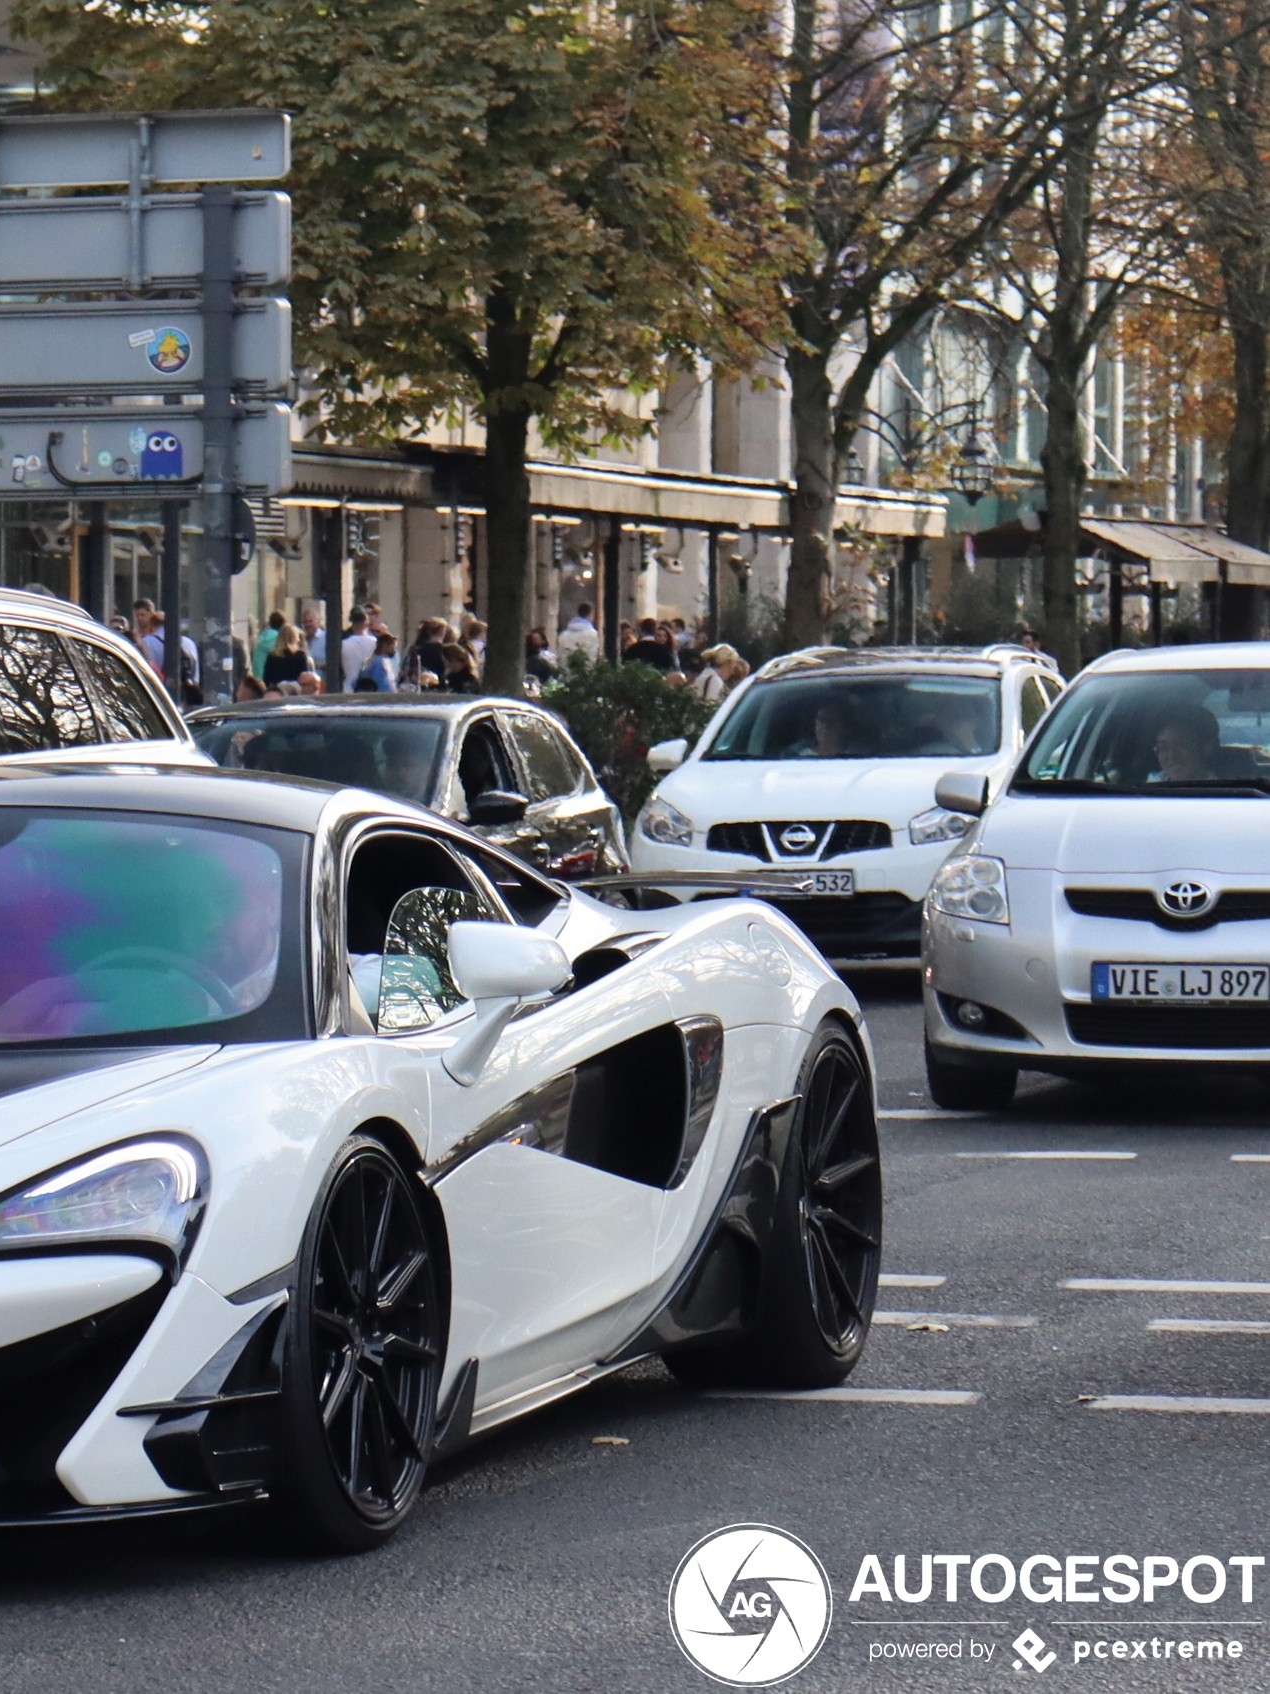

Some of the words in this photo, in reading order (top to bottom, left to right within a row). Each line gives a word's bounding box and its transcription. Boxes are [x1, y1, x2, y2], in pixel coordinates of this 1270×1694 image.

[815, 874, 851, 892] 532
[1111, 968, 1160, 996] VIE
[1180, 969, 1213, 997] LJ
[1219, 970, 1267, 998] 897
